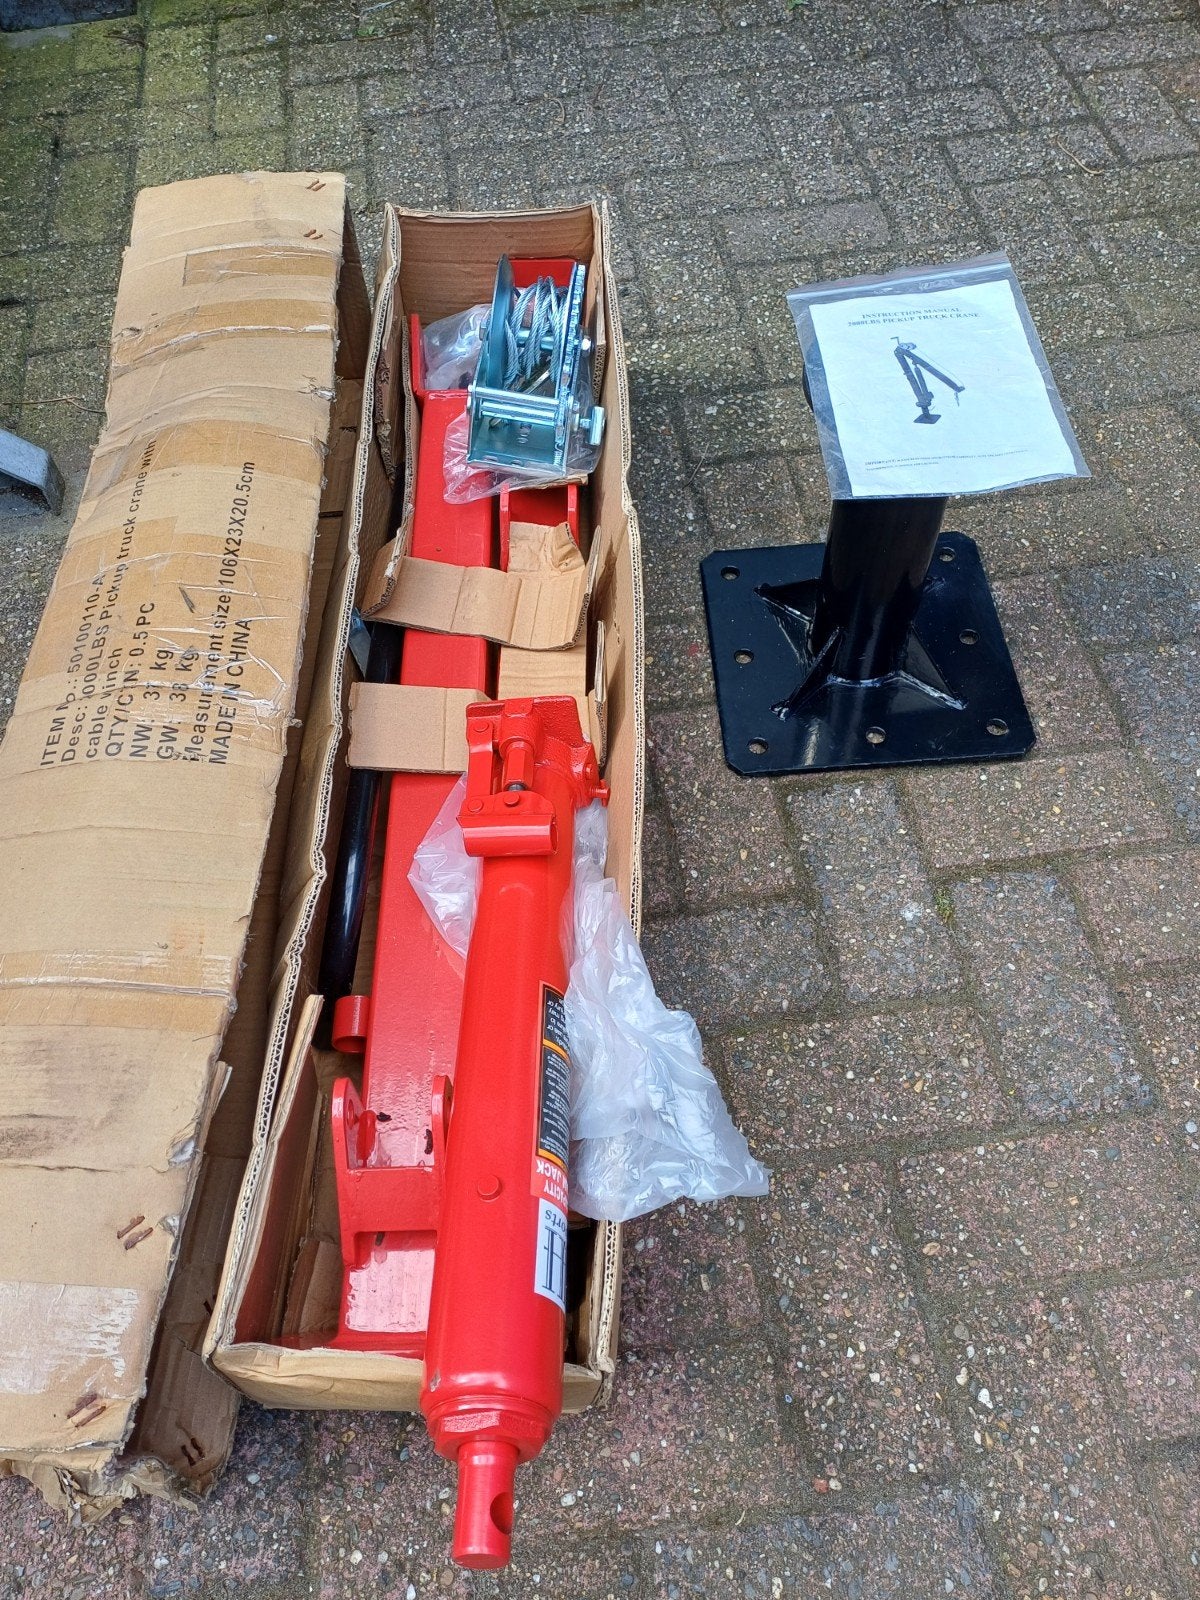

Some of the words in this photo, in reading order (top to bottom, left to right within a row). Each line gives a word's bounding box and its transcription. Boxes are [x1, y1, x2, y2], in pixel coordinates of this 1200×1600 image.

[862, 310, 921, 319] INSTRUCTION
[61, 706, 87, 762] Desc:
[98, 563, 128, 620] Pickup
[115, 517, 137, 560] truck
[126, 471, 148, 512] crane
[138, 440, 157, 468] with
[136, 603, 155, 626] PC
[183, 634, 224, 762] Measurement
[218, 461, 255, 586] 106X23X20.5cm
[40, 717, 66, 766] ITEM
[68, 575, 105, 673] 50100110-A
[129, 632, 148, 657] 0.5
[227, 618, 252, 676] CHINA
[129, 719, 155, 758] NW:
[150, 650, 173, 670] kg
[156, 721, 181, 759] GW:
[174, 650, 199, 671] kg
[220, 683, 241, 701] IN
[85, 705, 108, 758] cable
[208, 706, 237, 765] MADE
[536, 1159, 561, 1182] JACK
